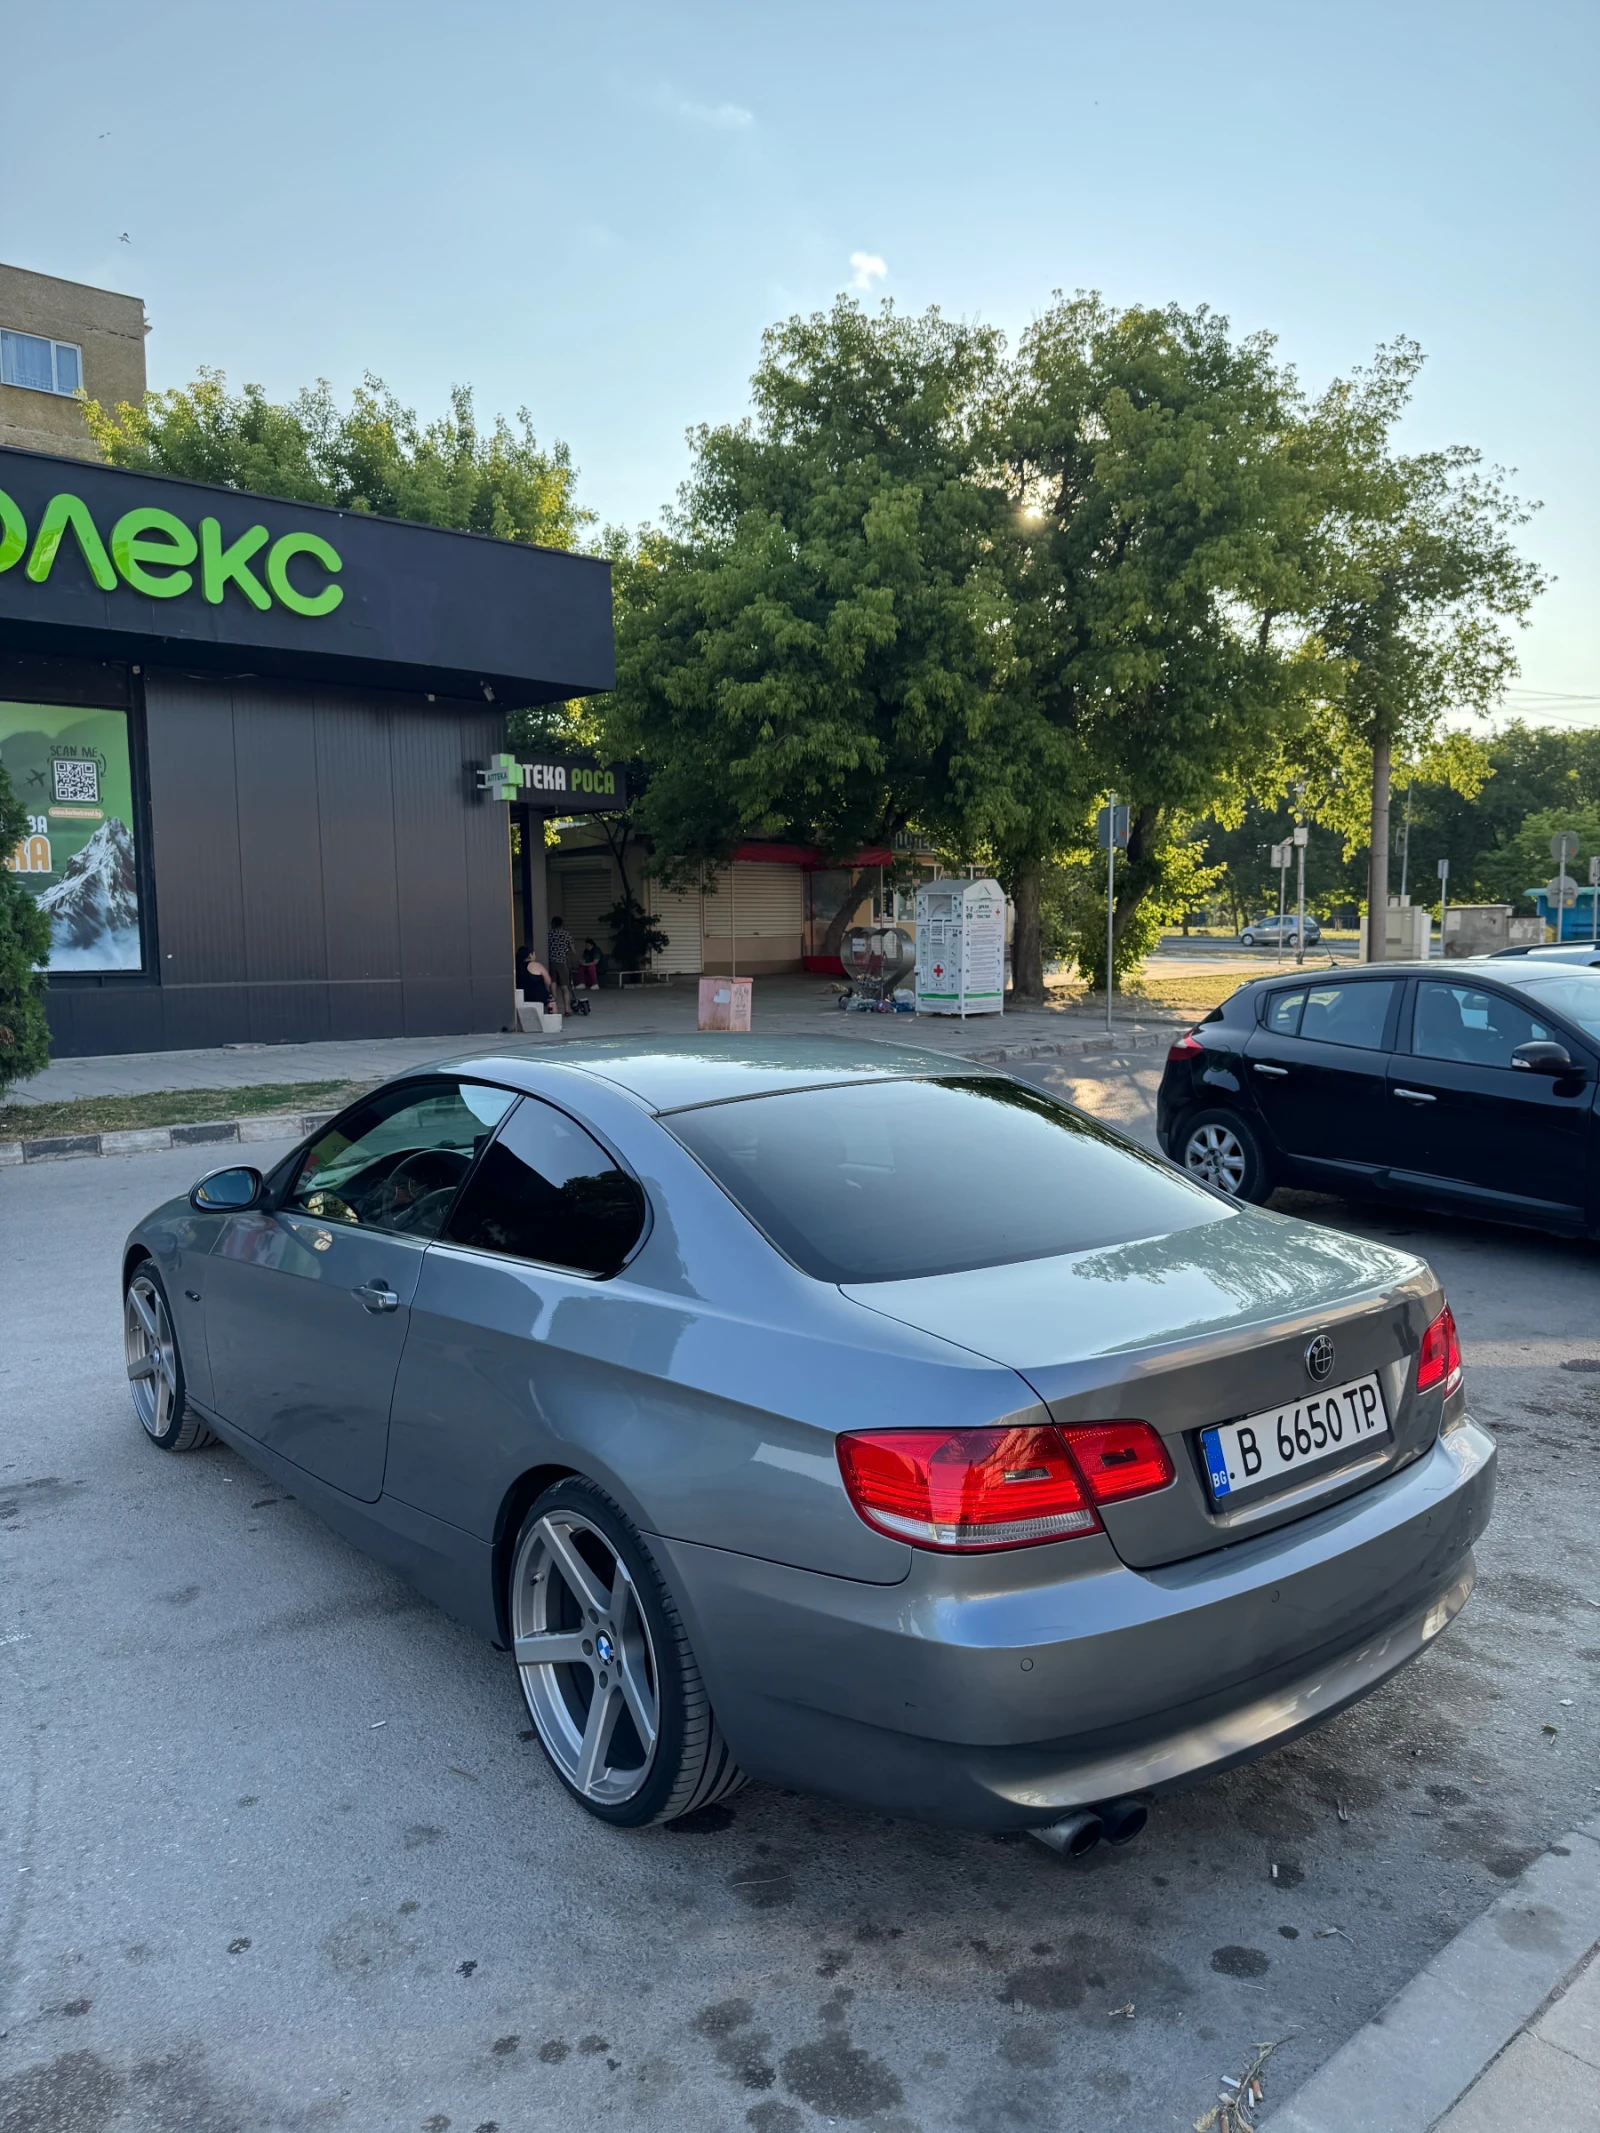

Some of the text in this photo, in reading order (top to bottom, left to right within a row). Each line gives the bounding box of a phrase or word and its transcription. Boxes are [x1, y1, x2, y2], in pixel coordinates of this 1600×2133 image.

[50, 745, 98, 758] SCAN ME
[516, 763, 615, 795] ТЕКА РОСА
[1236, 1383, 1377, 1477] B 6650 TP
[1211, 1470, 1228, 1488] BG
